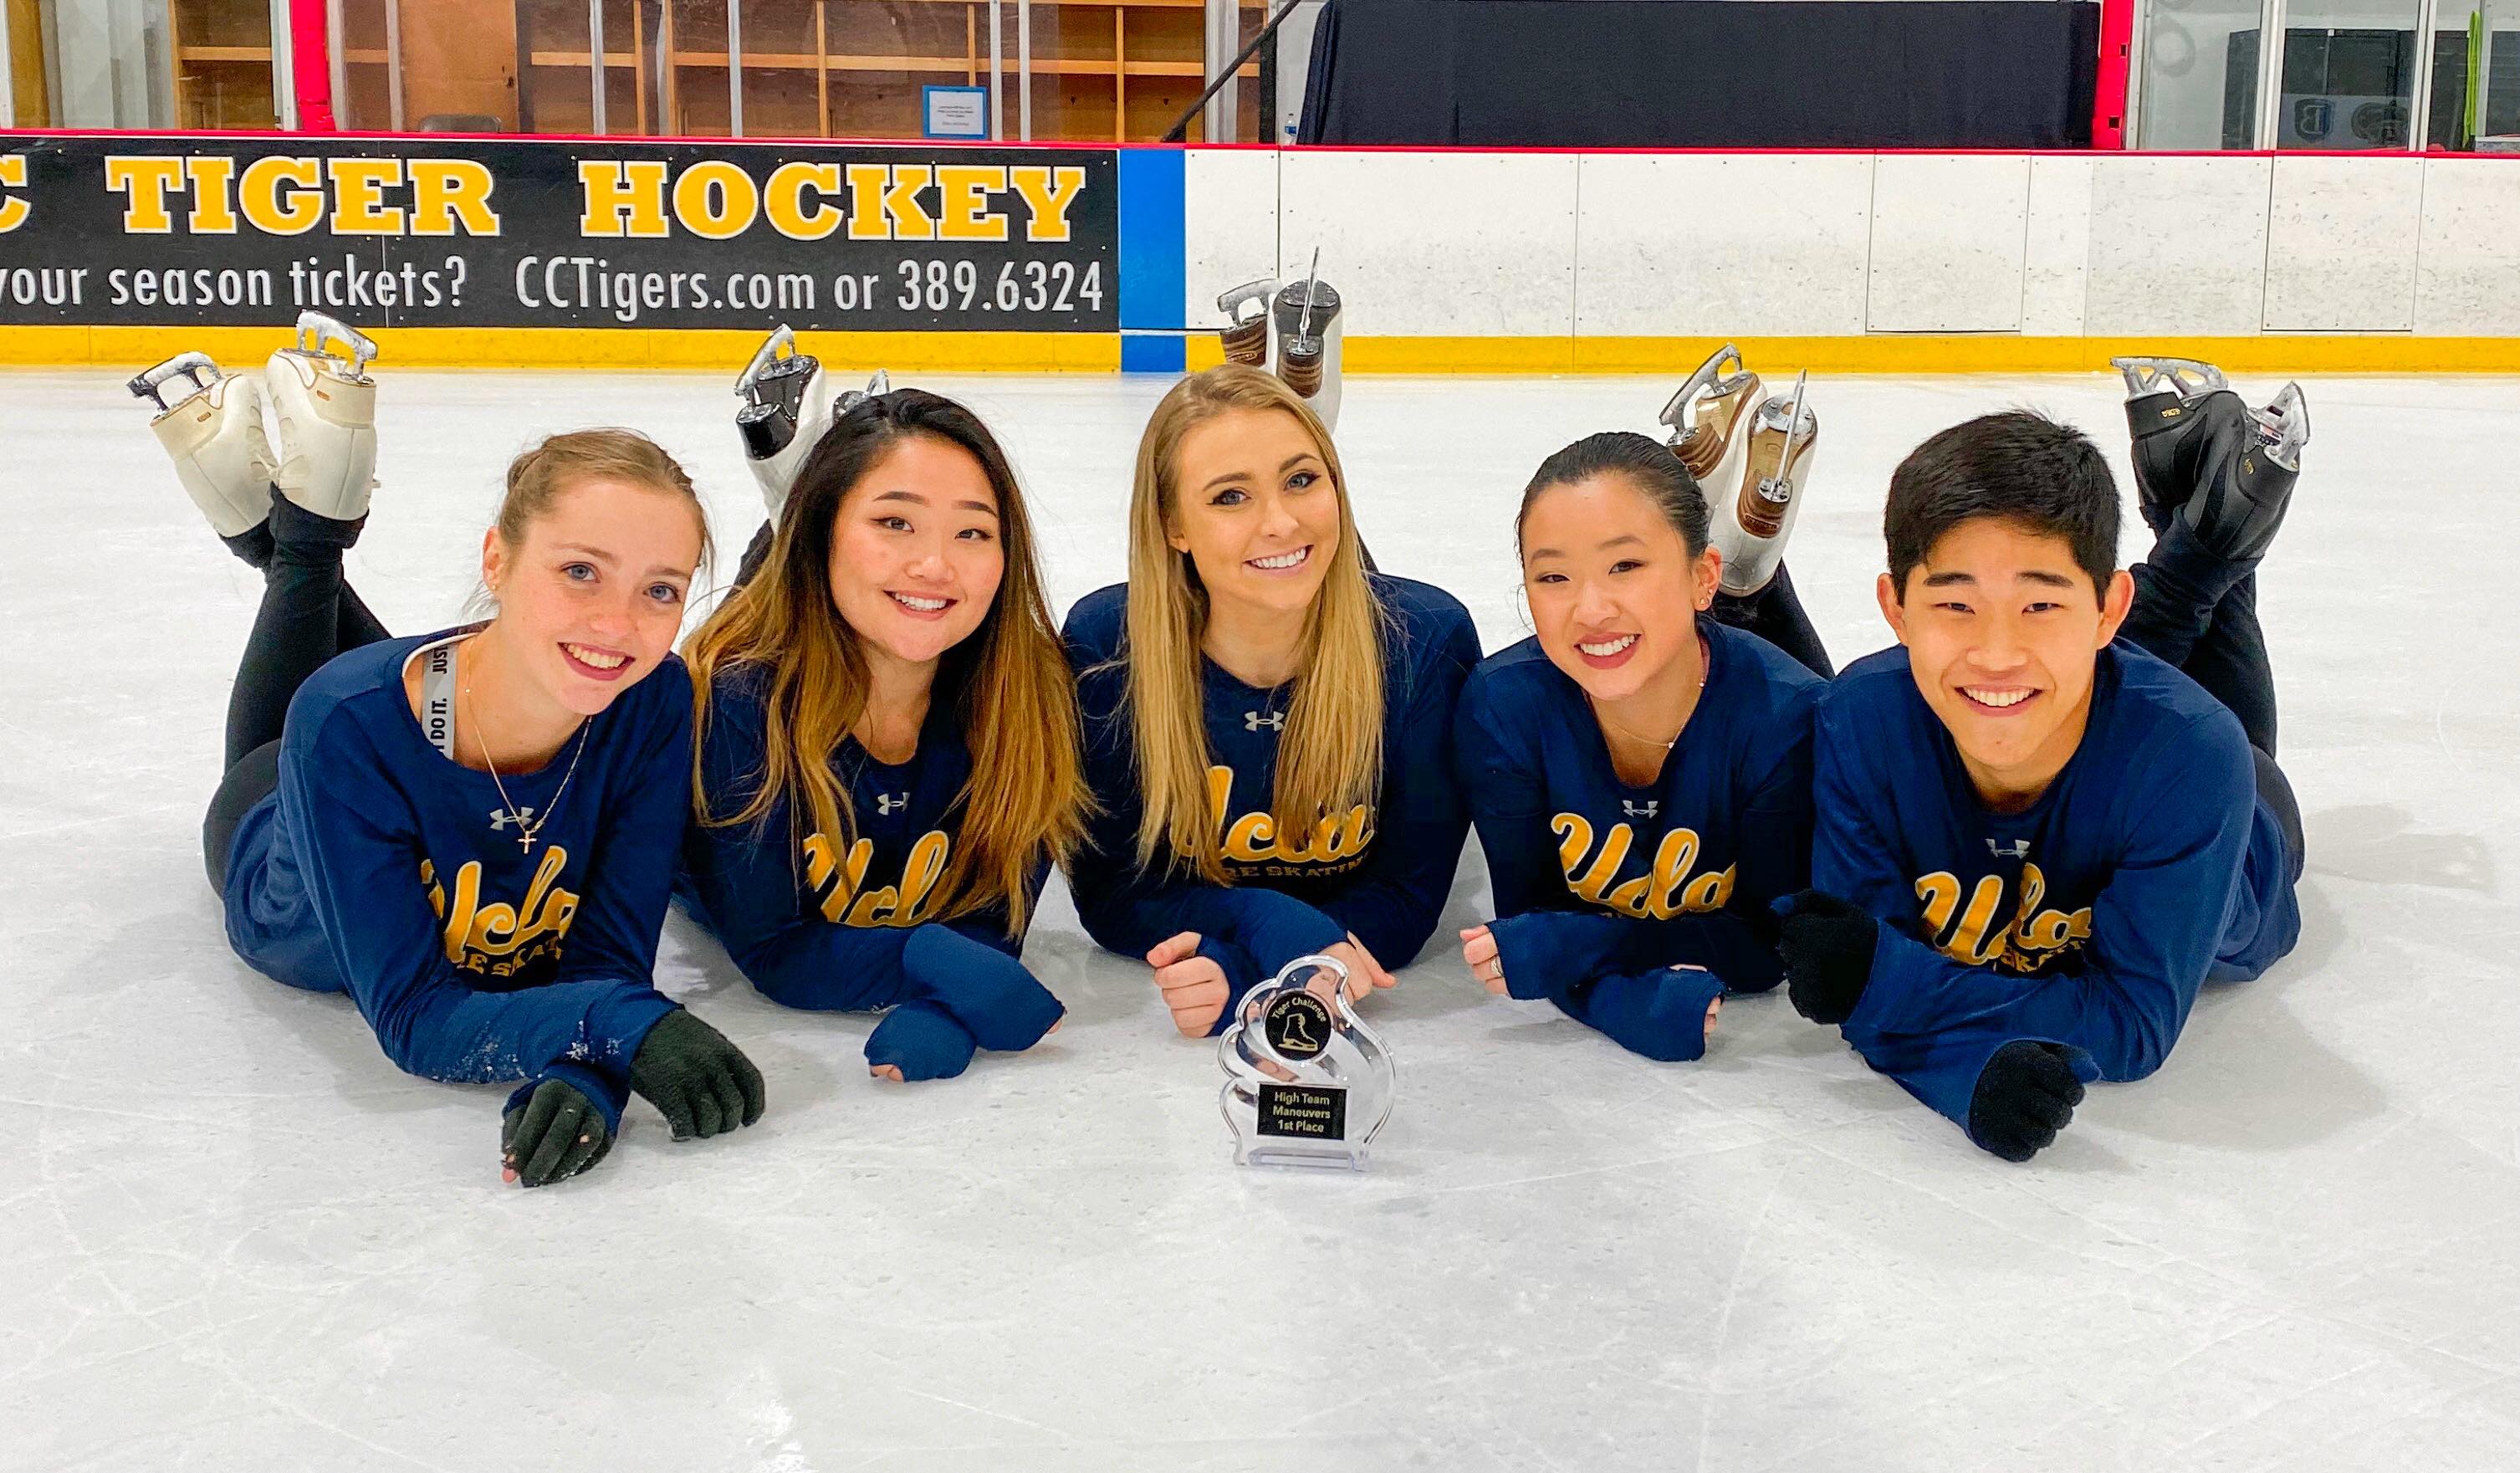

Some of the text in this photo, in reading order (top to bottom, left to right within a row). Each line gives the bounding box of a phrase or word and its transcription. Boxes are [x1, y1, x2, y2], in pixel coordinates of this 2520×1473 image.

[104, 156, 502, 238] TIGER
[577, 160, 1086, 243] HOCKEY
[110, 267, 272, 307] season
[289, 253, 467, 309] tickets?
[515, 255, 816, 323] CCTigers.com
[834, 274, 879, 311] or
[897, 258, 1102, 314] 389.6324
[431, 698, 447, 715] IT.
[430, 718, 446, 739] DO
[803, 831, 949, 928] Ucl
[1271, 997, 1326, 1022] Tiger Challenge
[1274, 1091, 1330, 1105] High Team
[1272, 1105, 1331, 1119] Maneuvers
[1278, 1119, 1325, 1133] 1st Place
